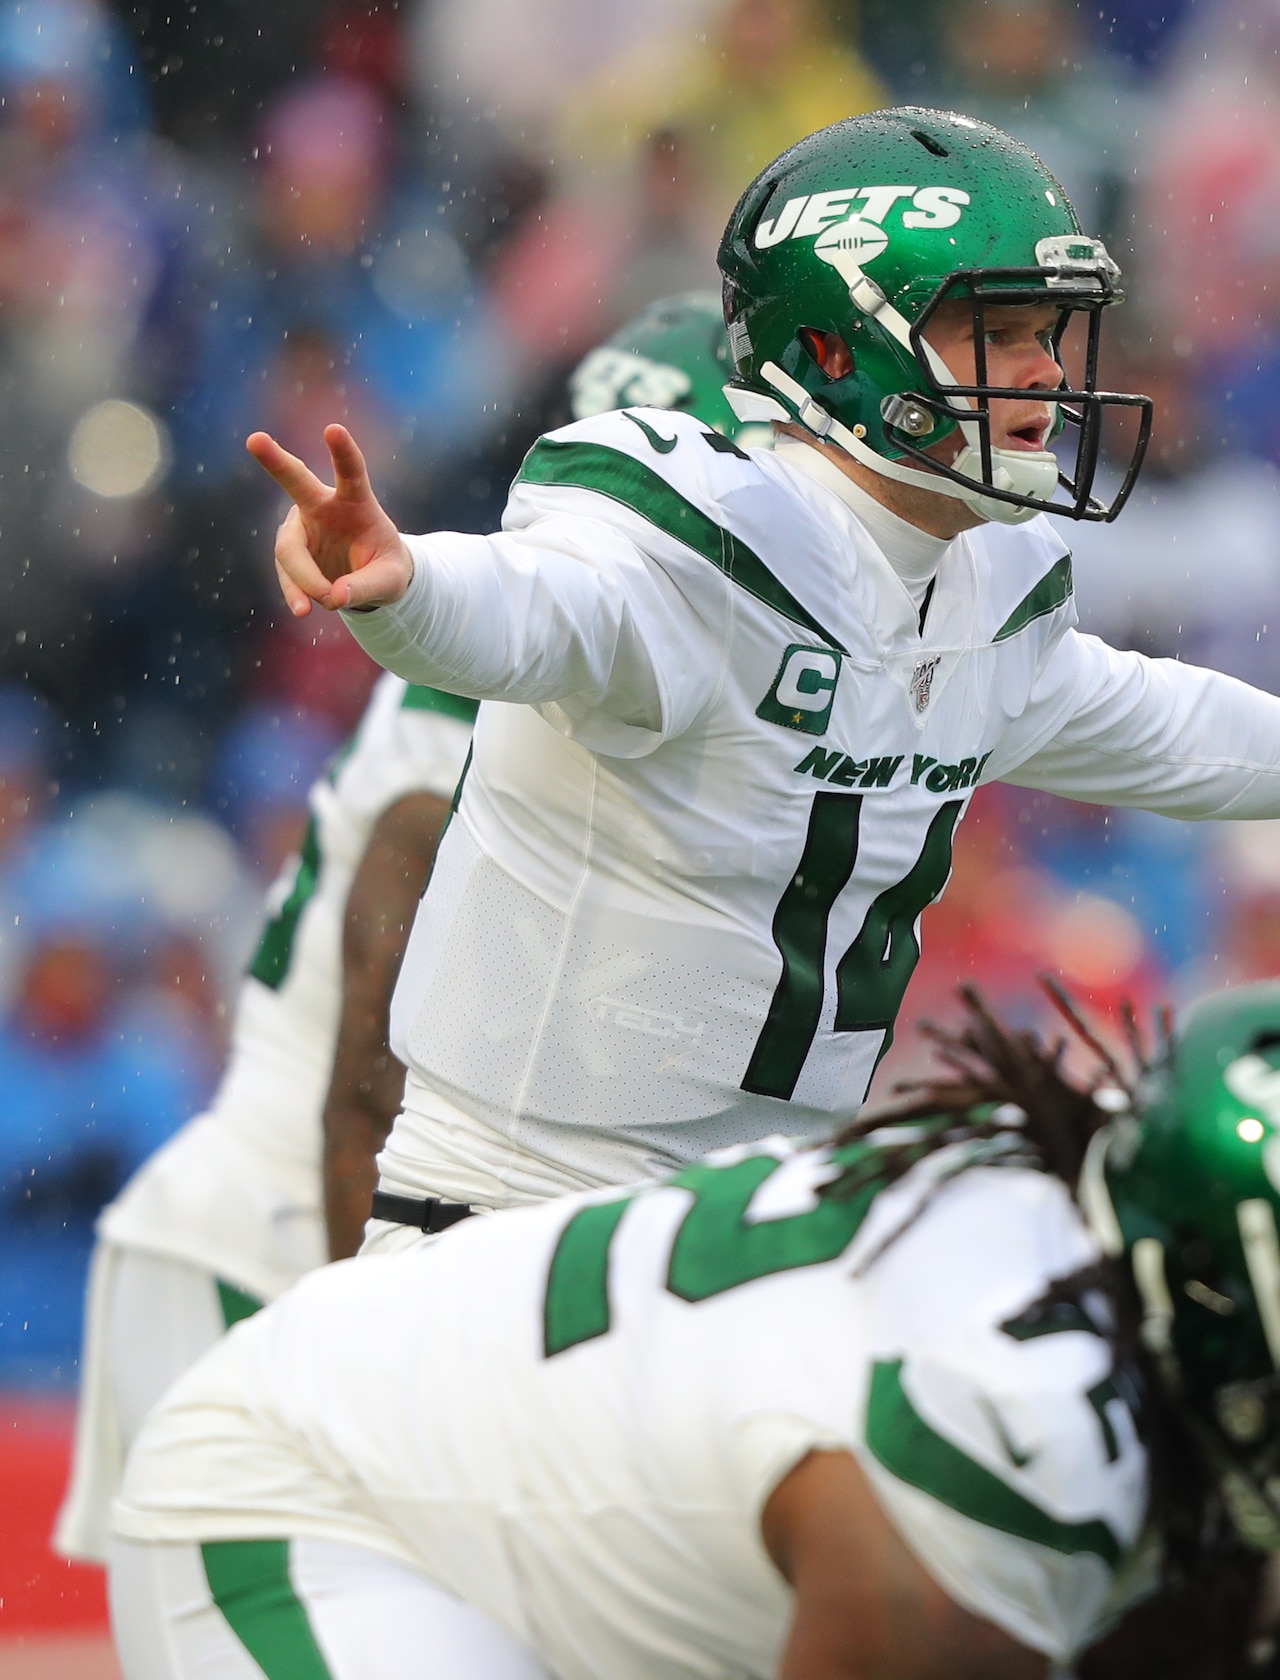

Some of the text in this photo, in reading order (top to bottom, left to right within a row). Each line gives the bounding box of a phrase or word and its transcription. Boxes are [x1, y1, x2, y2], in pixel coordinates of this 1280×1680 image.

[754, 185, 971, 250] JETS
[775, 650, 837, 713] C
[793, 745, 905, 788] NEW
[740, 790, 965, 1105] 14
